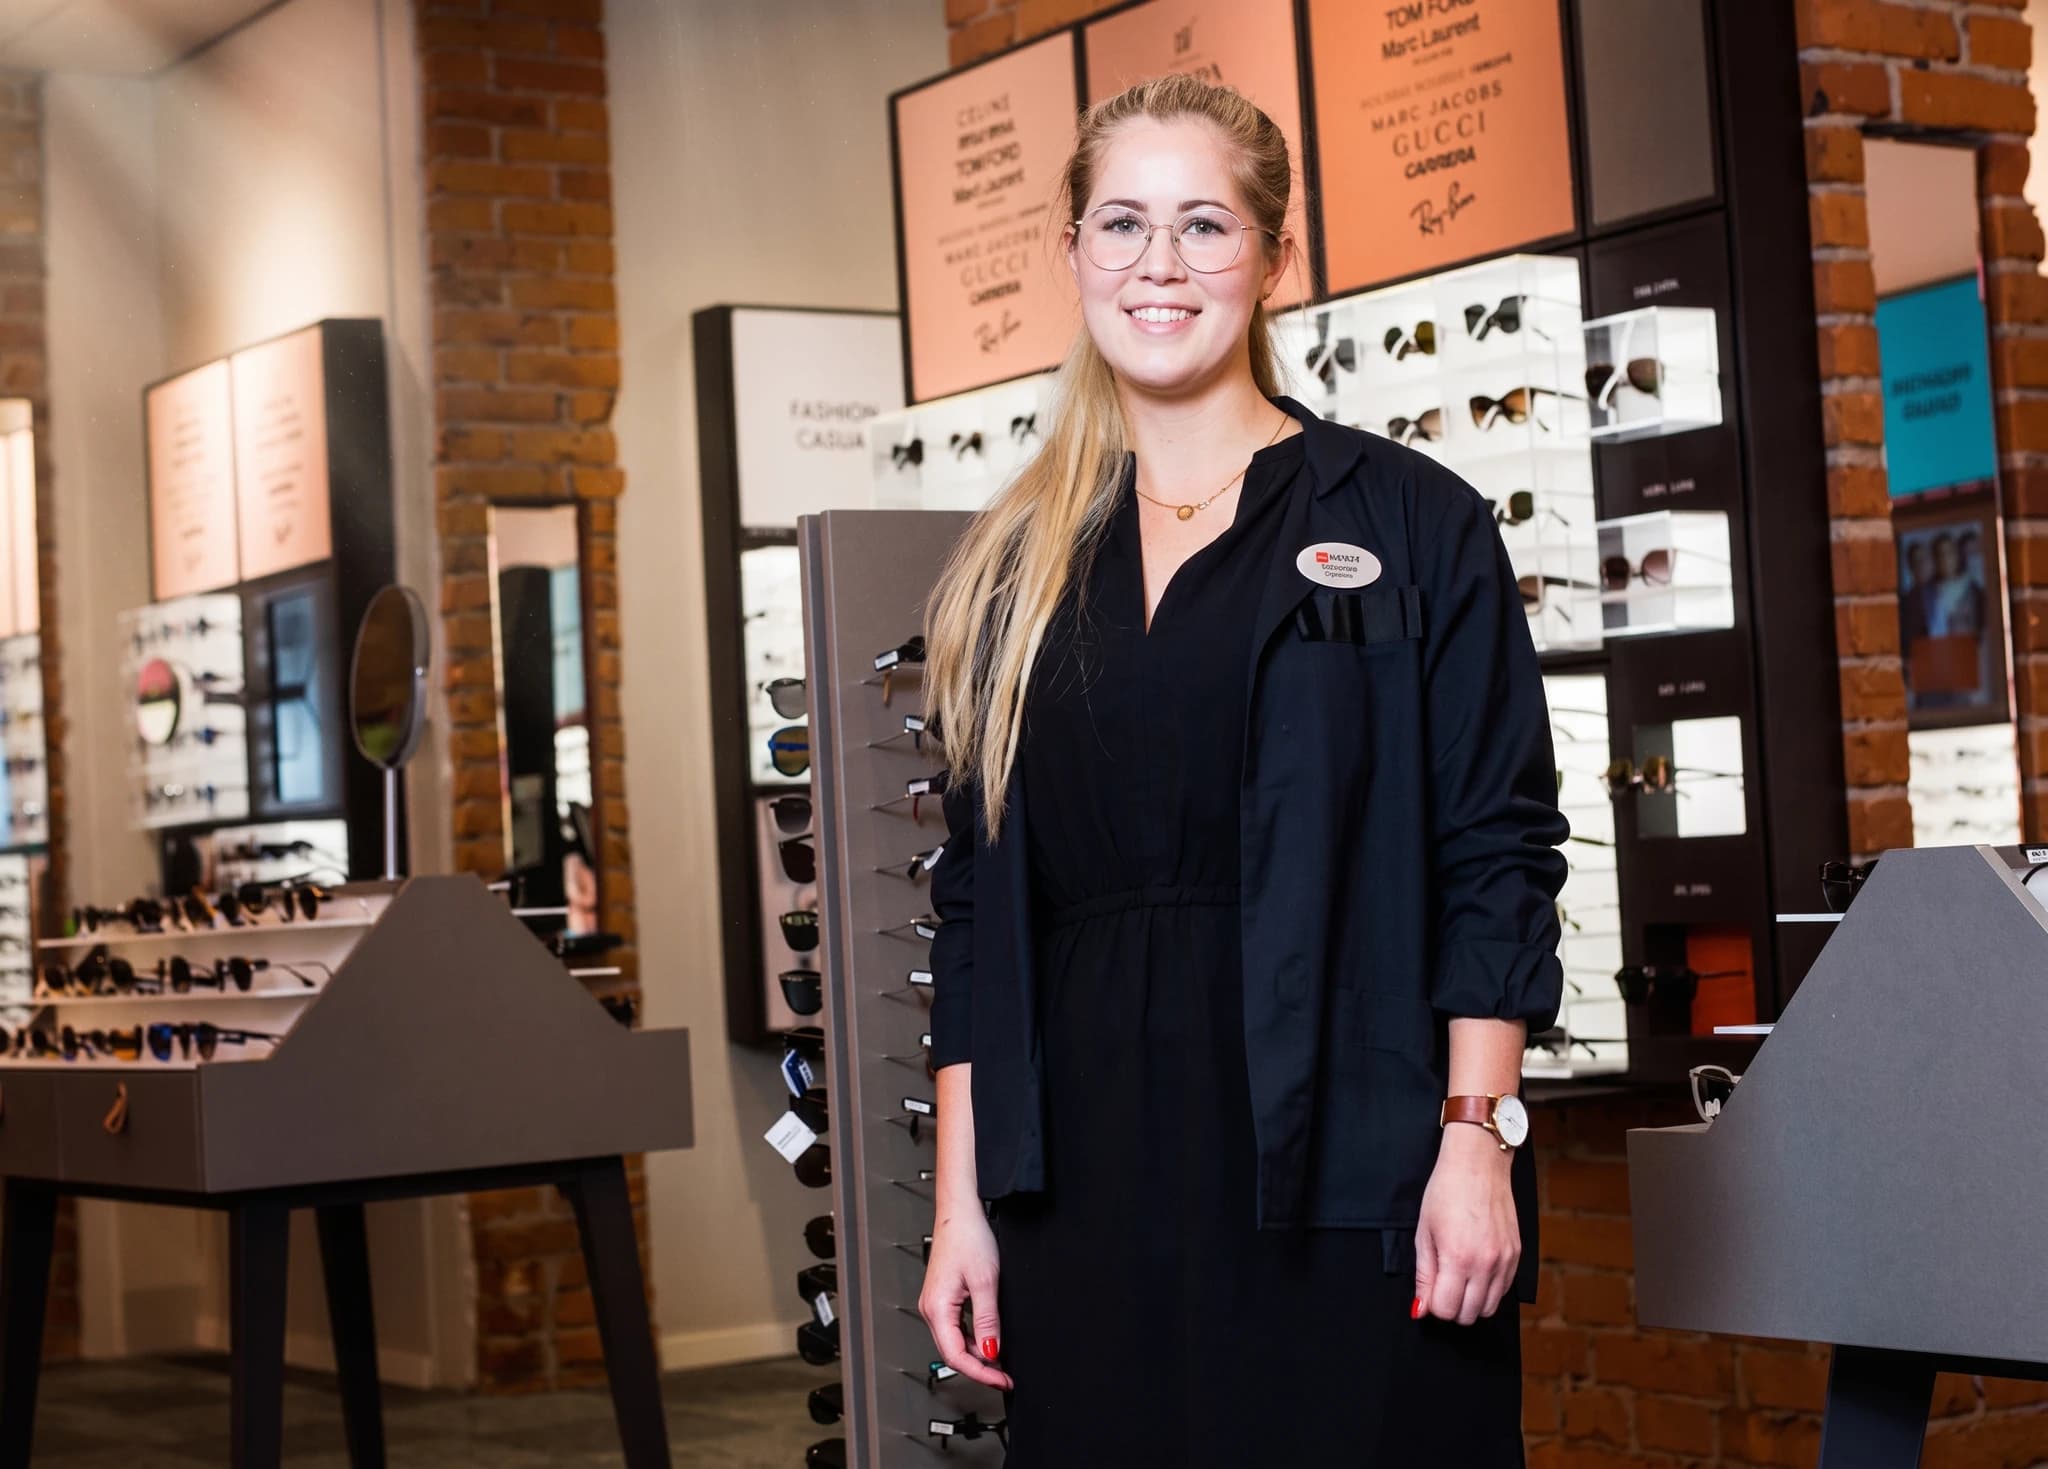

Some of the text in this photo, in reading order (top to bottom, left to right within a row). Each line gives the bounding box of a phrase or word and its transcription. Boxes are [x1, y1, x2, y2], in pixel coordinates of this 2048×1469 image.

[1381, 36, 1419, 60] Marc
[1421, 13, 1481, 48] Laurent
[1385, 0, 1476, 30] TOM FO
[1371, 104, 1421, 132] MARC
[1430, 79, 1503, 117] JACOBS
[1392, 109, 1486, 157] GUCCI
[1404, 146, 1477, 180] CARRERA
